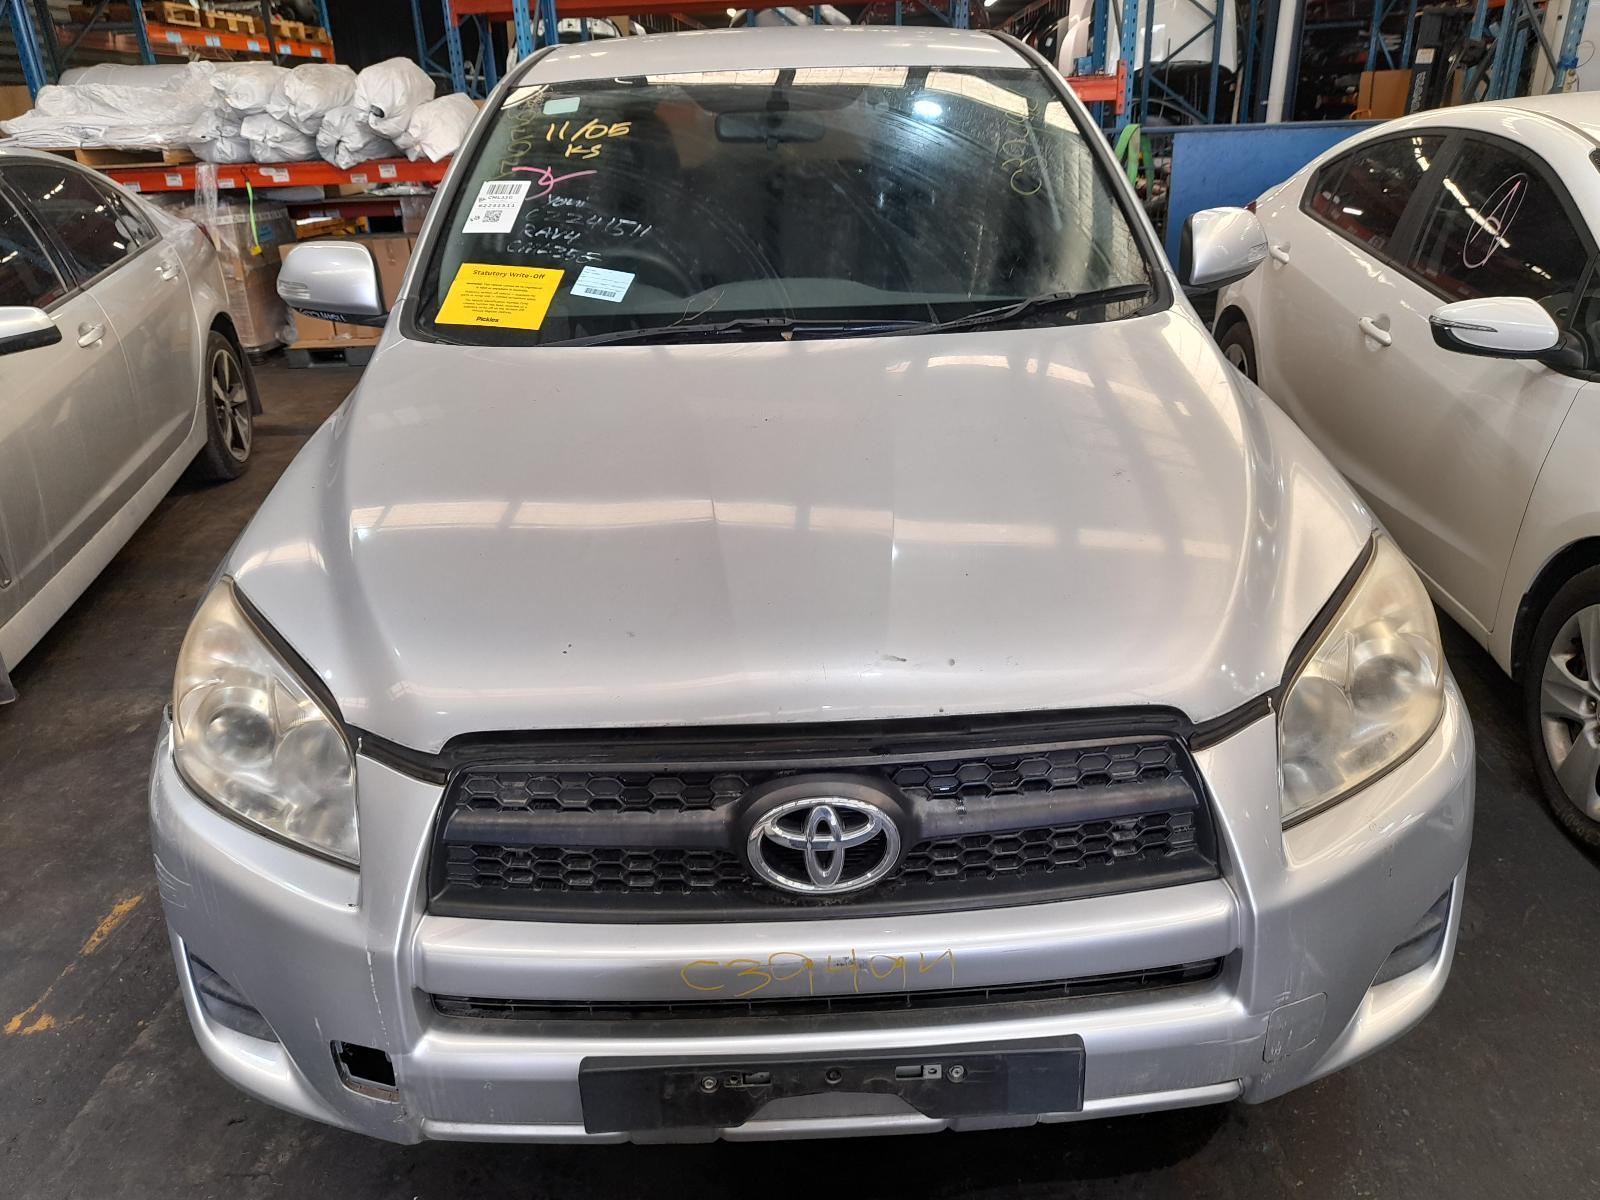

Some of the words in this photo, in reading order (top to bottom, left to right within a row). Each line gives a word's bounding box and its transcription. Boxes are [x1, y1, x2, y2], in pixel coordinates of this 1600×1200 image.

[565, 143, 602, 160] KS
[524, 223, 581, 245] RAV4
[472, 269, 508, 280] Statutory
[509, 272, 547, 280] Write-Off
